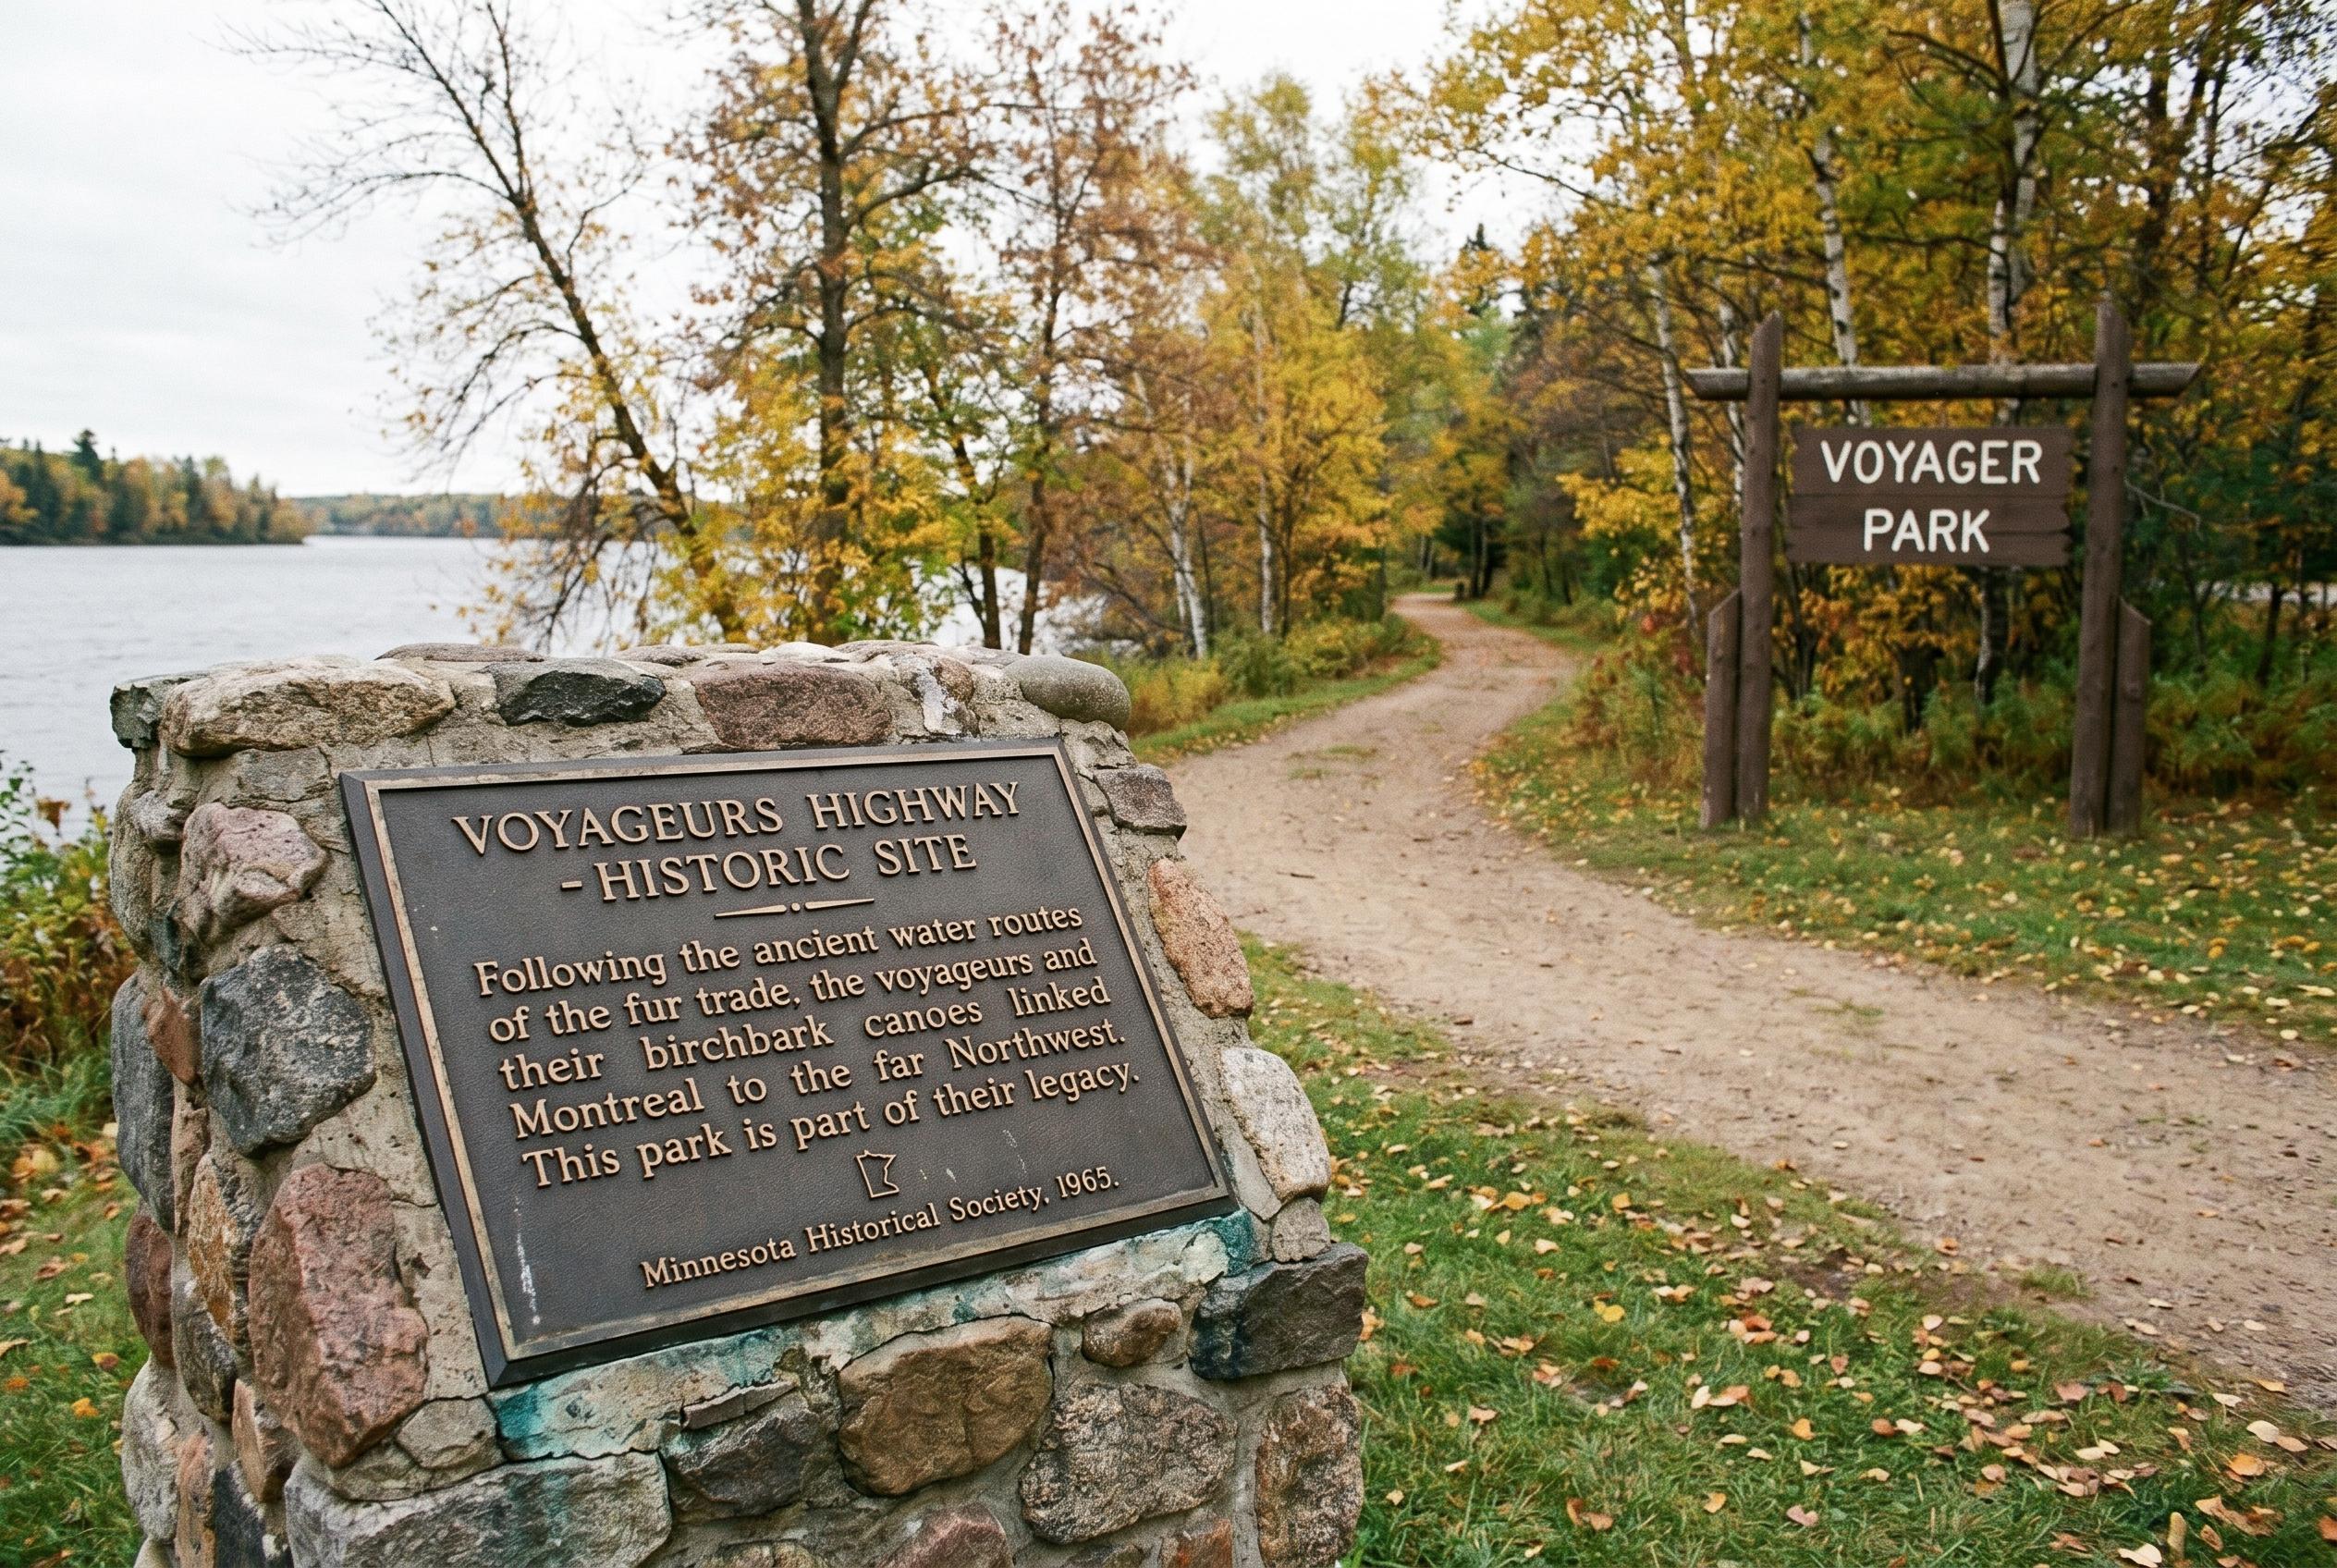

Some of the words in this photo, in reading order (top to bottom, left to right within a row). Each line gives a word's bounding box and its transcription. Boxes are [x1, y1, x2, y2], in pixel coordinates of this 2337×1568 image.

[1820, 439, 2043, 484] VOYAGER
[1864, 508, 1990, 553] PARK
[452, 798, 784, 856] VOYAGEURS
[806, 780, 1020, 828] HIGHWAY
[875, 833, 977, 875] SITE
[474, 950, 667, 997] Following
[679, 939, 740, 972] the
[753, 925, 879, 963] ancient
[887, 918, 976, 947] water
[987, 905, 1083, 937] routes
[490, 1005, 530, 1042] of
[544, 999, 612, 1035] the
[623, 991, 682, 1024] fur
[695, 976, 801, 1015] trade,
[809, 969, 866, 1000] the
[875, 953, 1034, 995] voyageurs
[1043, 937, 1098, 970] and
[499, 1047, 605, 1089] their
[641, 1015, 835, 1071] birchbark
[865, 1002, 983, 1038] canoes
[1007, 975, 1111, 1016] linked
[509, 1077, 704, 1140] Montreal
[727, 1074, 767, 1104] to
[790, 1060, 852, 1094] the
[874, 1049, 924, 1081] far
[946, 1018, 1126, 1071] Northwest.
[521, 1143, 620, 1186] This
[636, 1122, 732, 1178] park
[743, 1118, 777, 1149] is
[790, 1101, 871, 1150] part
[885, 1089, 920, 1124] of
[933, 1077, 1015, 1116] their
[1025, 1062, 1139, 1102] legacy.
[642, 1238, 797, 1287] Minnesota
[805, 1202, 941, 1252] Historical
[949, 1186, 1050, 1220] Society,
[1056, 1166, 1120, 1197] 1965.
